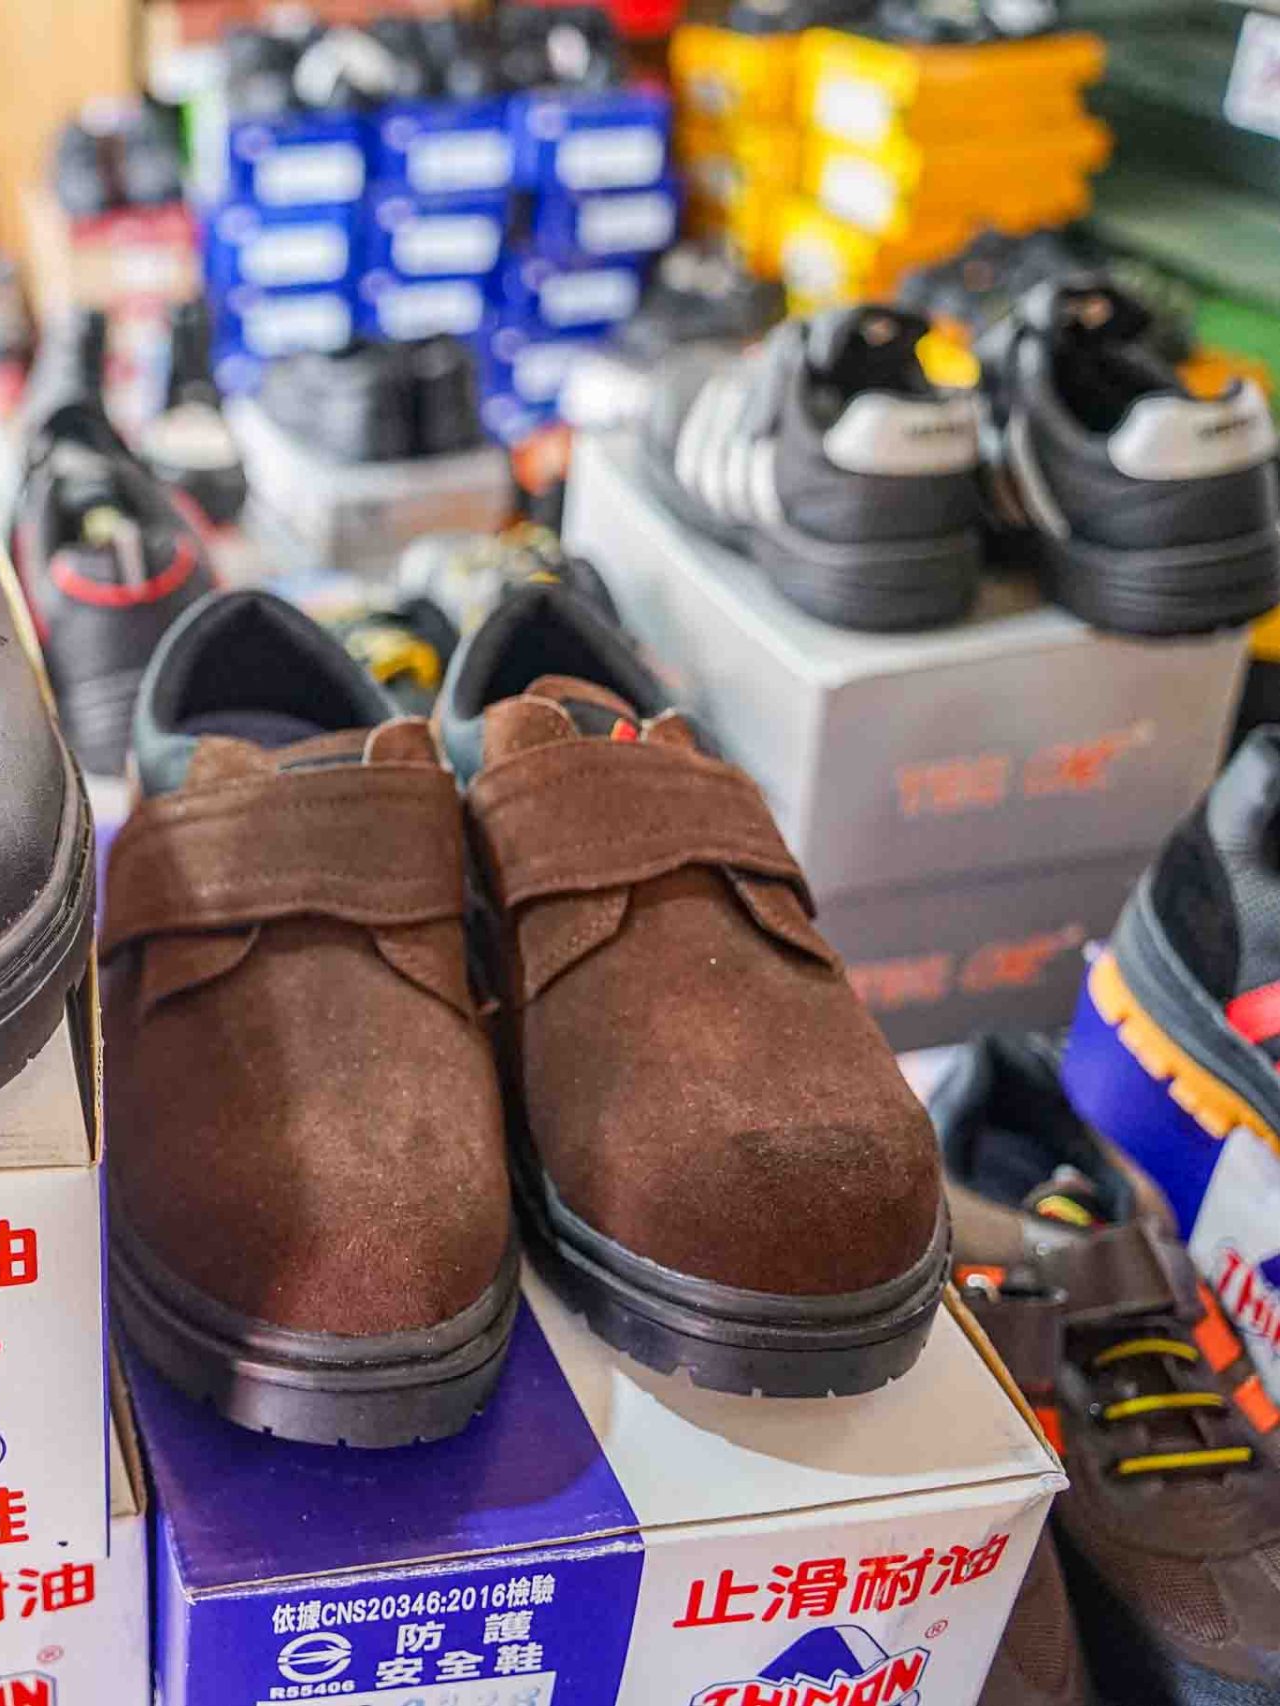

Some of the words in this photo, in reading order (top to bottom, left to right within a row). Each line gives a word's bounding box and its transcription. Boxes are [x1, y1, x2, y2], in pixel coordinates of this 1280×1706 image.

[271, 1573, 556, 1634] 依據CNS20346:2016檢驗
[673, 1533, 1010, 1628] 止滑耐油
[269, 1680, 356, 1700] R55406
[375, 1642, 544, 1689] 安全鞋
